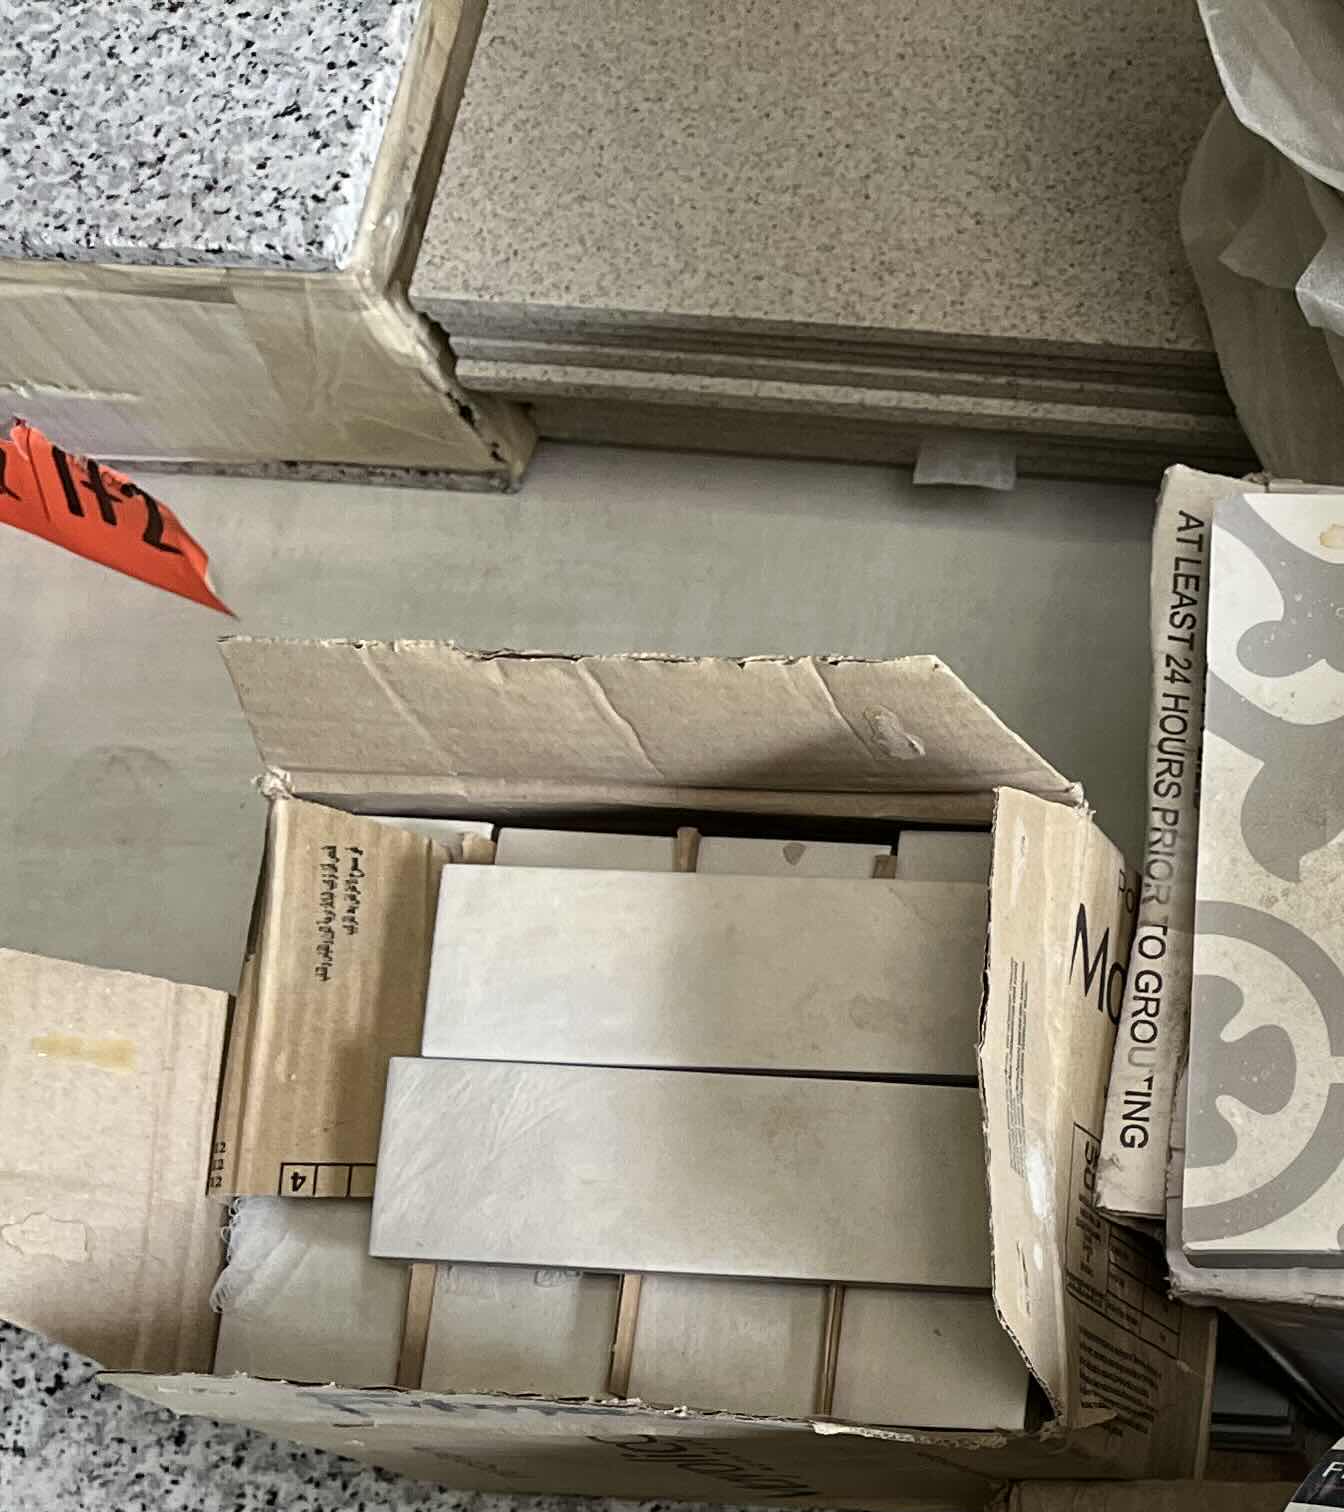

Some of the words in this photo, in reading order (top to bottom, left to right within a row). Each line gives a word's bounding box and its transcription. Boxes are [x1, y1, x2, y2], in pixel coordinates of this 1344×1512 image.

[1176, 510, 1205, 550] AT
[1167, 557, 1201, 652] LEAST
[1164, 654, 1192, 685] 24
[1152, 693, 1189, 798] HOURS
[1141, 807, 1179, 906] PRIOR
[1137, 913, 1170, 961] TO
